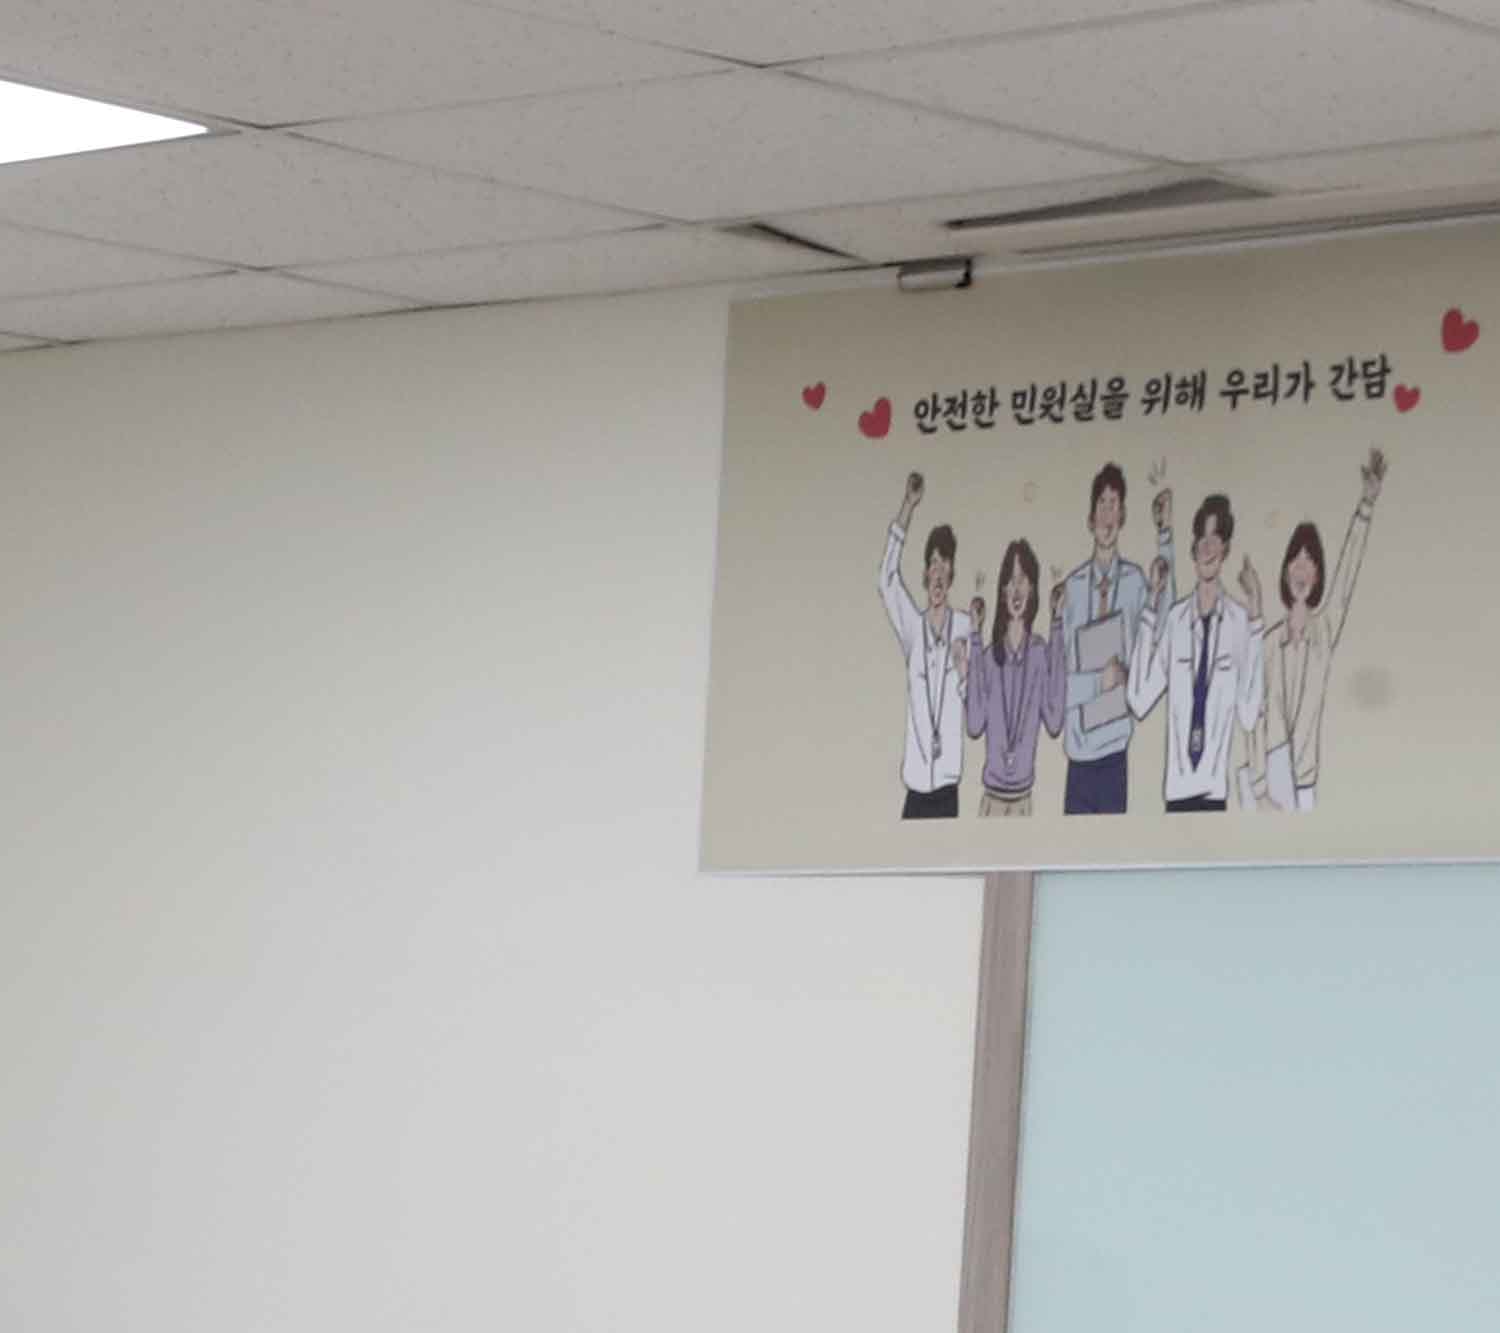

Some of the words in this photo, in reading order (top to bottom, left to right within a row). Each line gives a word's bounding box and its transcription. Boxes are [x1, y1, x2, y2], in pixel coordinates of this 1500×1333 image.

[914, 387, 1000, 434] 안전한
[1012, 376, 1129, 425] 민원실을
[1141, 370, 1206, 415] 위해
[1220, 361, 1315, 410] 우리가
[1330, 354, 1391, 401] 간담
